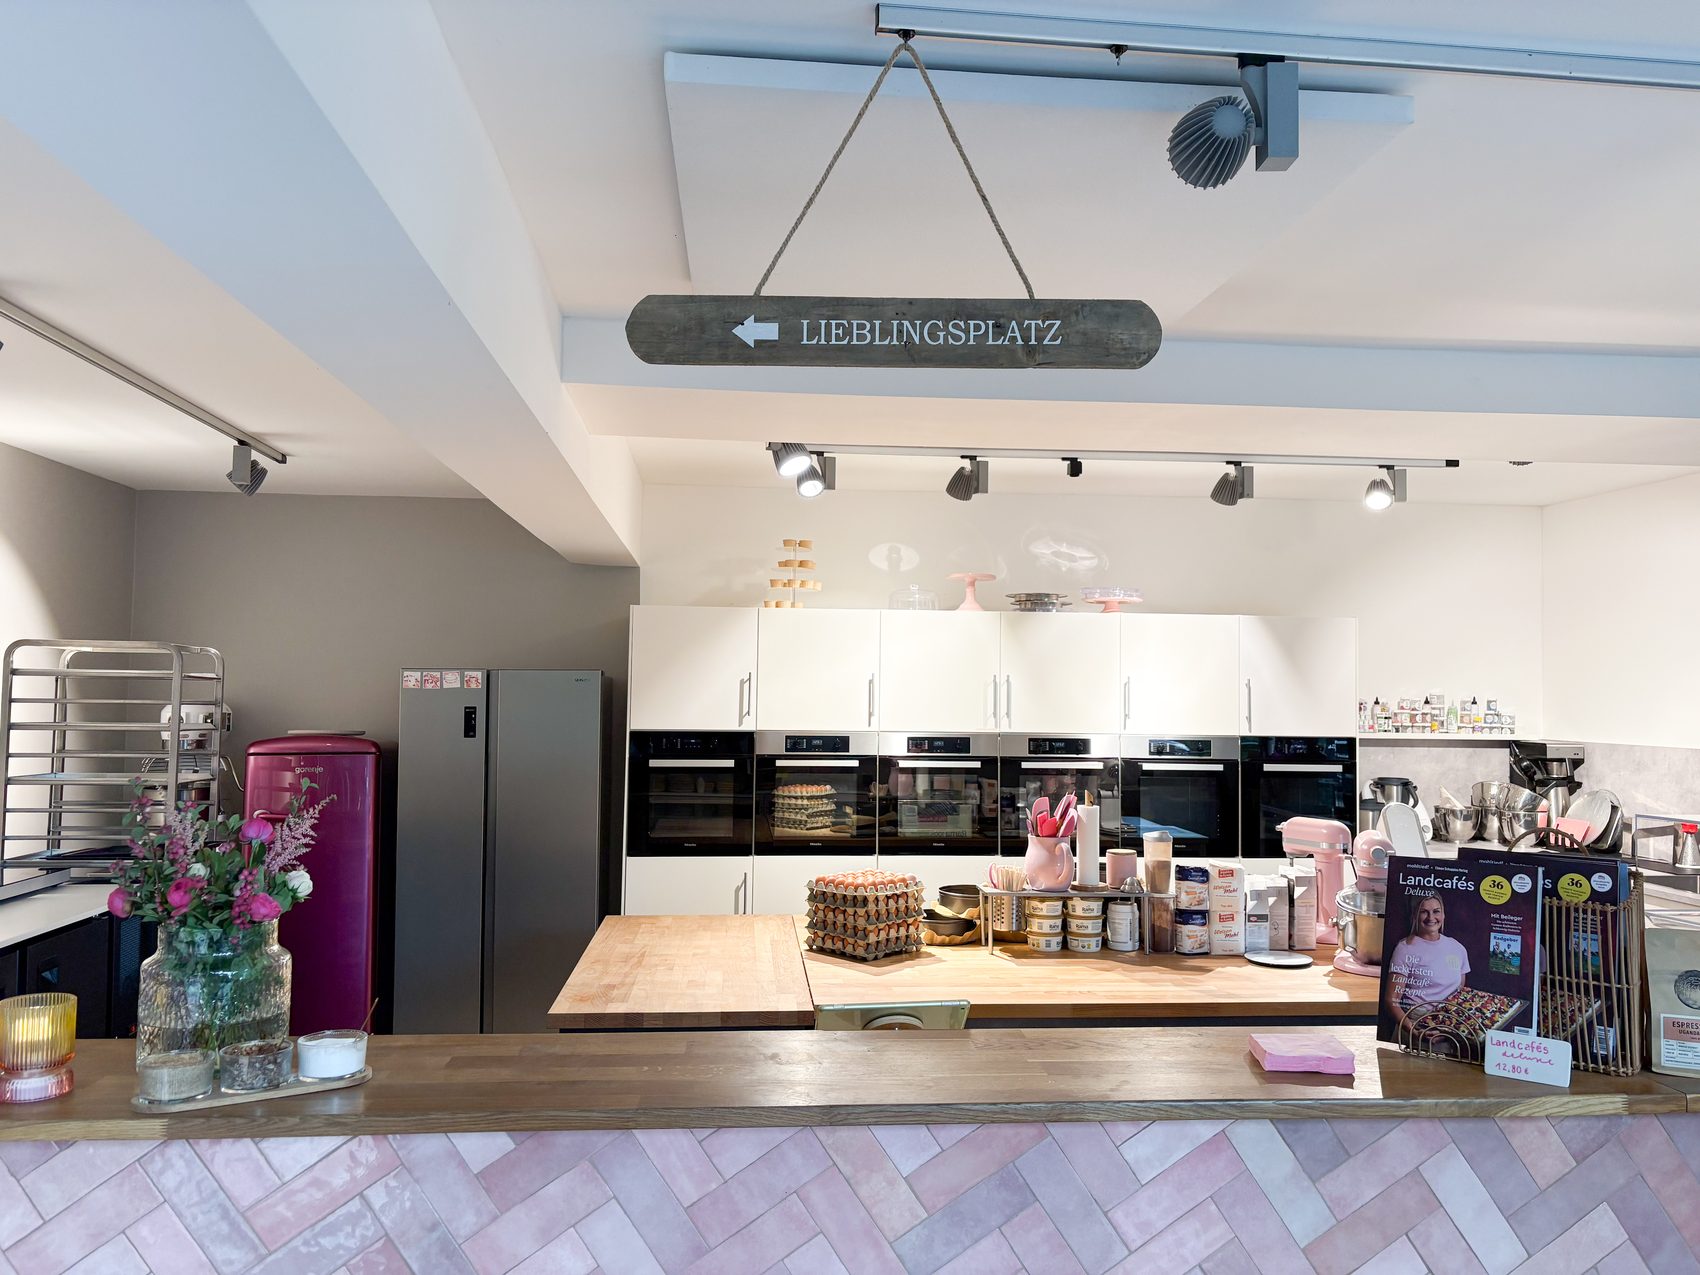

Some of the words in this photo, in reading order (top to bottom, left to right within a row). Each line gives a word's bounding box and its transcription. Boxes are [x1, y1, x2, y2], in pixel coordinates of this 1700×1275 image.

[800, 319, 1063, 347] LIEBLINGSPLATZ
[294, 766, 324, 775] gorenje
[1399, 872, 1475, 892] Landcafés
[1488, 879, 1504, 890] 36
[1567, 877, 1583, 889] 36
[1404, 886, 1436, 898] Deluxe
[1405, 954, 1420, 964] Die
[1391, 963, 1434, 977] leckersten
[1392, 974, 1433, 987] Landcafé-
[1394, 985, 1426, 998] Rezepte
[1672, 1020, 1700, 1031] ESPRES
[1490, 1035, 1549, 1055] Landcafés
